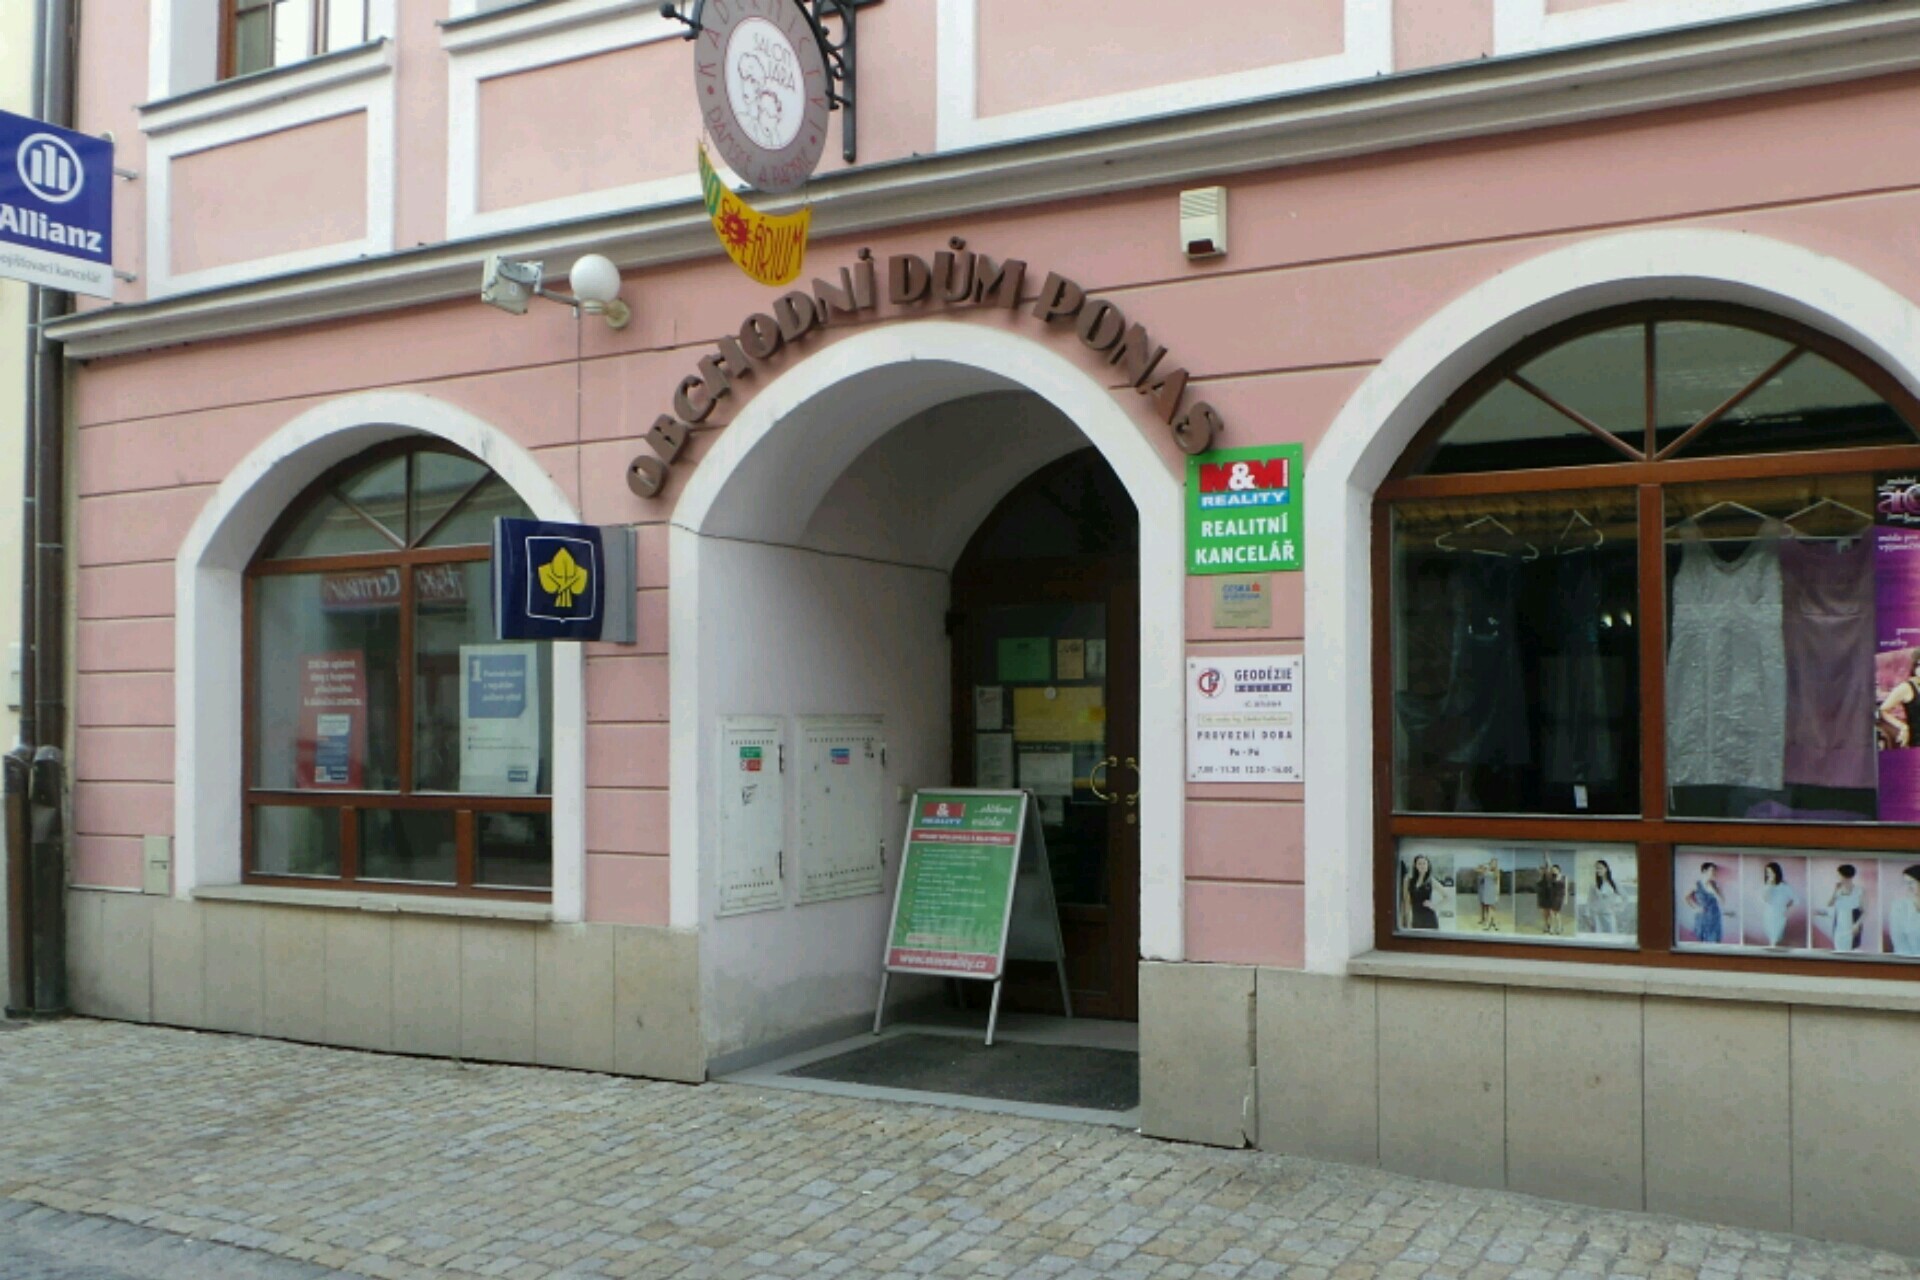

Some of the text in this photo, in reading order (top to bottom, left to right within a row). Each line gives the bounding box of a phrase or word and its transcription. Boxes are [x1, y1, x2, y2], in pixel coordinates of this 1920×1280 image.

[0, 203, 102, 252] Allianz
[626, 247, 876, 500] OBCHODNÍ
[888, 236, 1028, 311] DŮM
[1199, 459, 1289, 492] M&M
[1201, 491, 1286, 507] REALITY
[1201, 512, 1288, 537] REALITNÍ
[1195, 539, 1294, 564] KANCELÁŘ
[1234, 666, 1292, 681] GEODÉZIE
